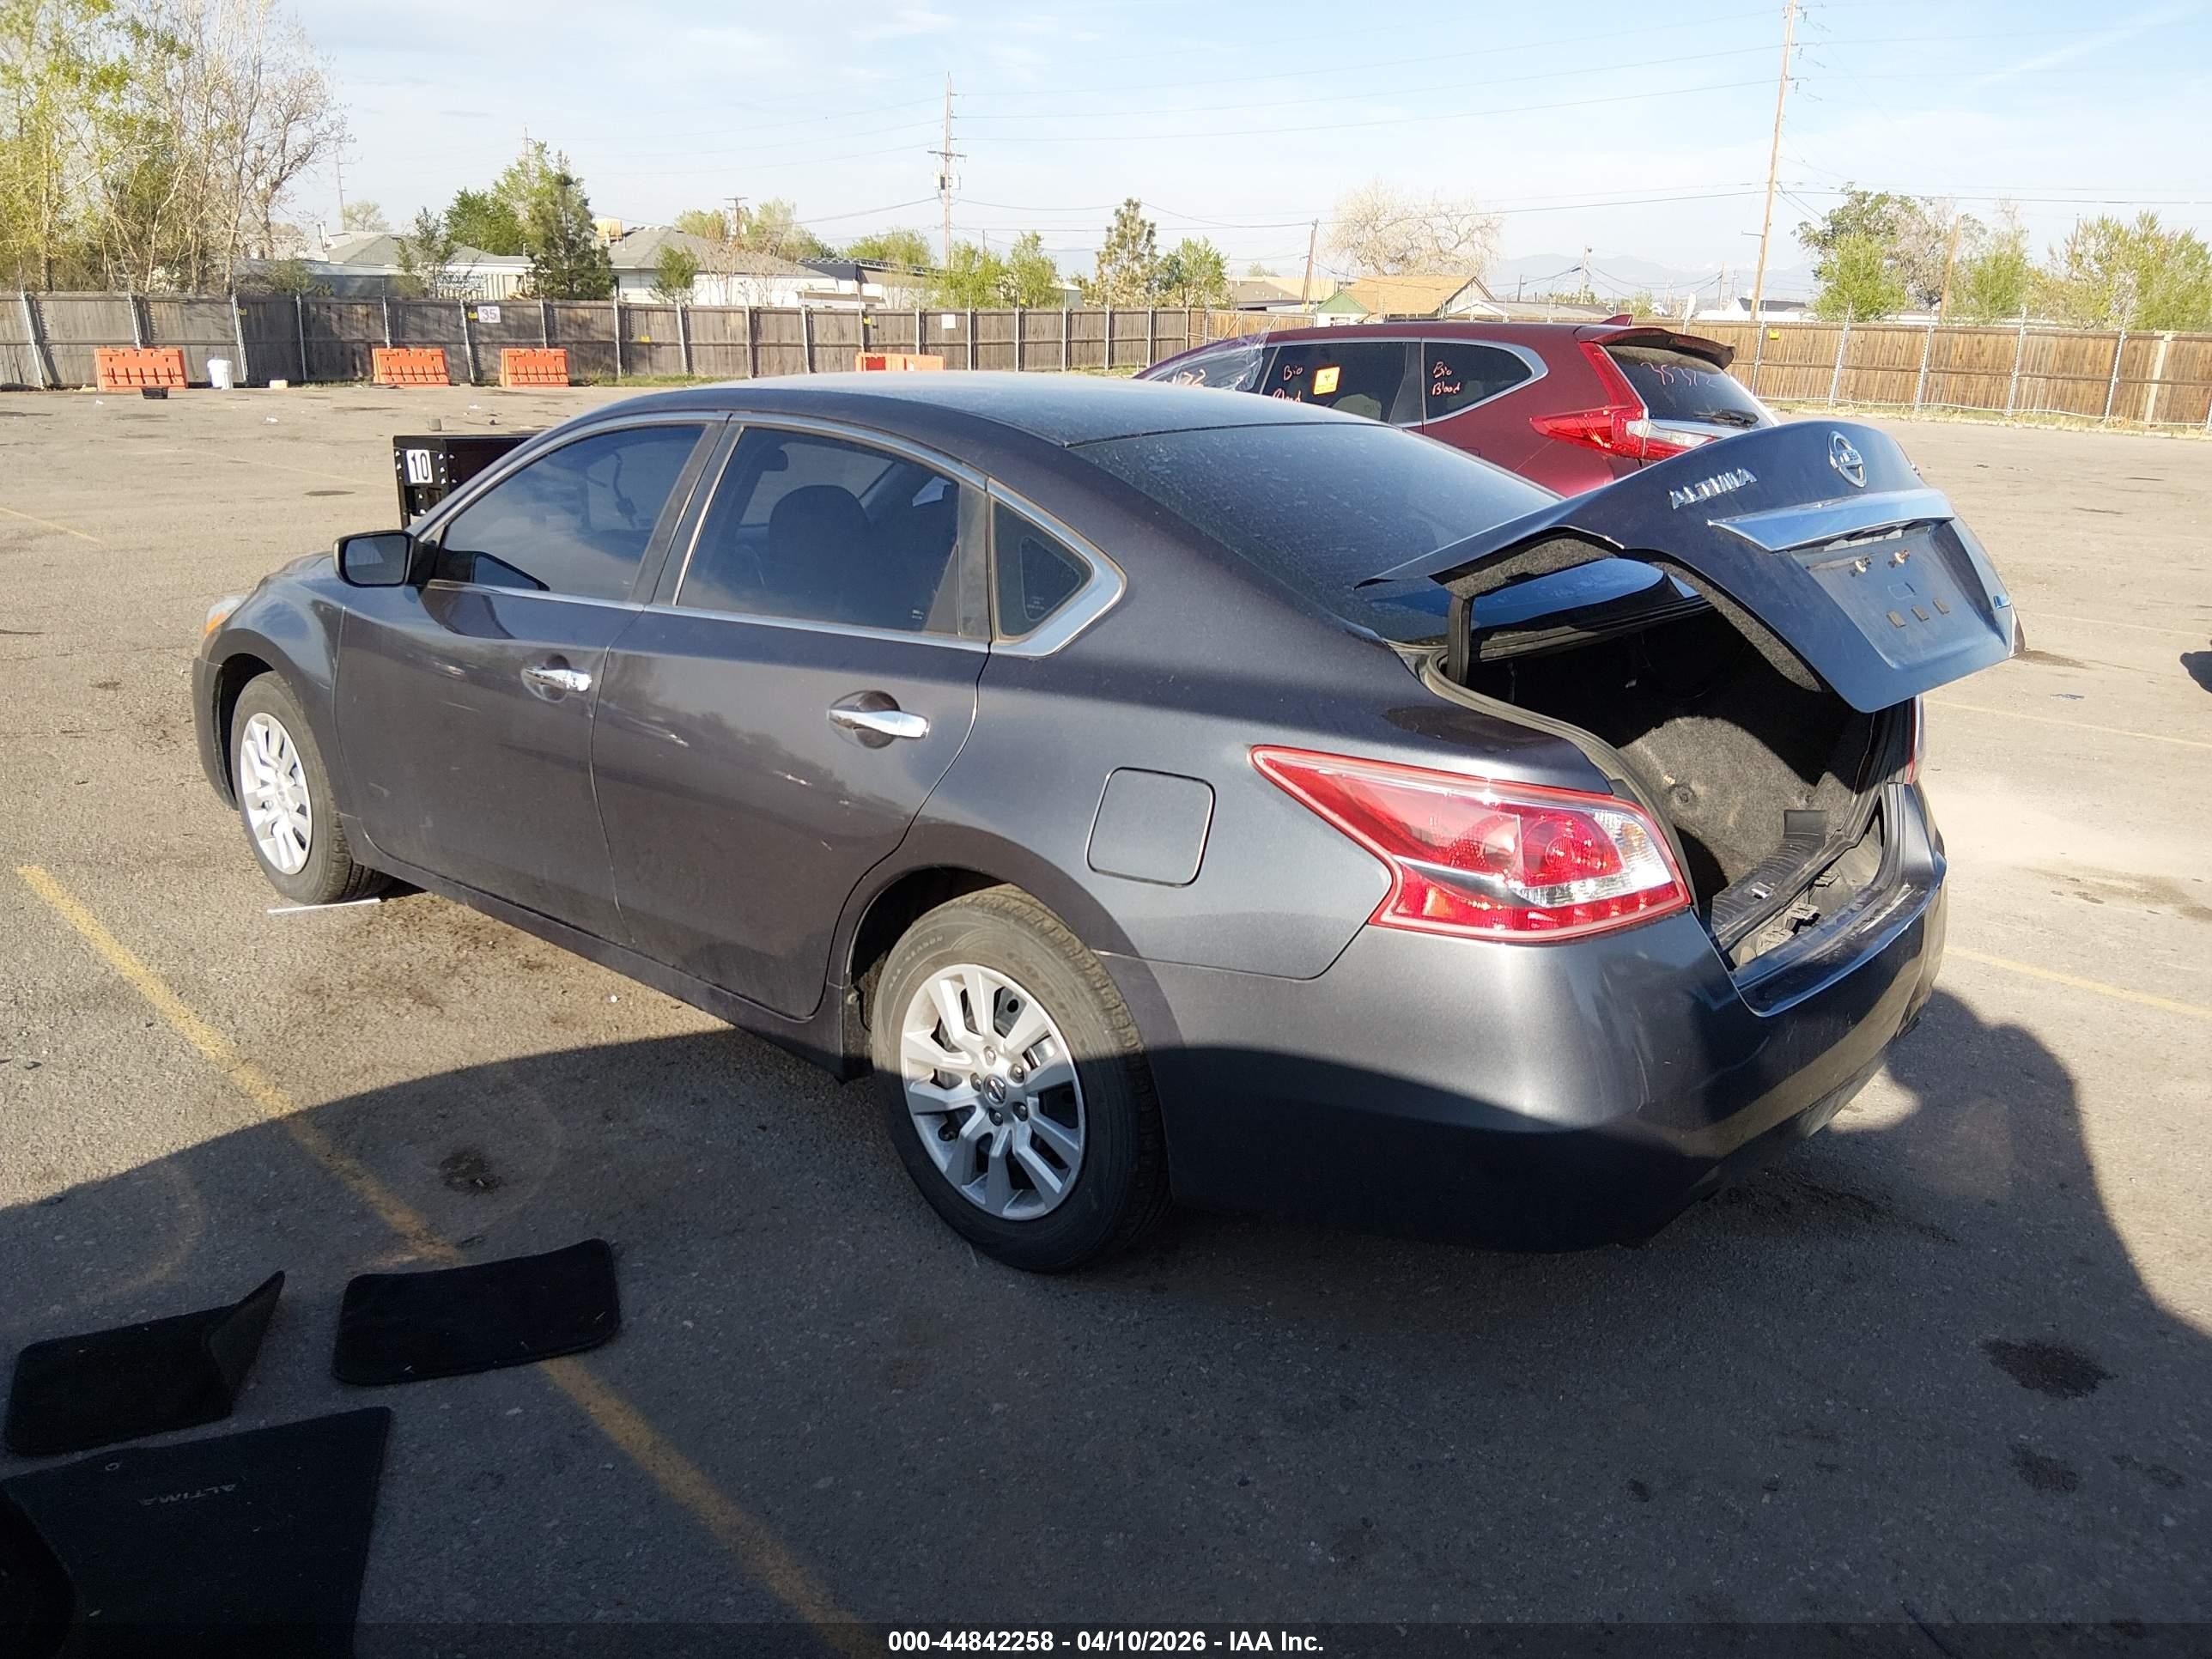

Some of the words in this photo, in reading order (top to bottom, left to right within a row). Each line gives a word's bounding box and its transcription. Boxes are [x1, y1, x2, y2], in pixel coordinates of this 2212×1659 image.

[482, 308, 496, 320] 35
[1283, 364, 1304, 381] Bio
[1433, 362, 1452, 379] Bio
[1431, 380, 1461, 396] Blood
[411, 453, 430, 481] 10
[1668, 468, 1758, 510] ALTIMA
[137, 1483, 237, 1507] ALTIMA
